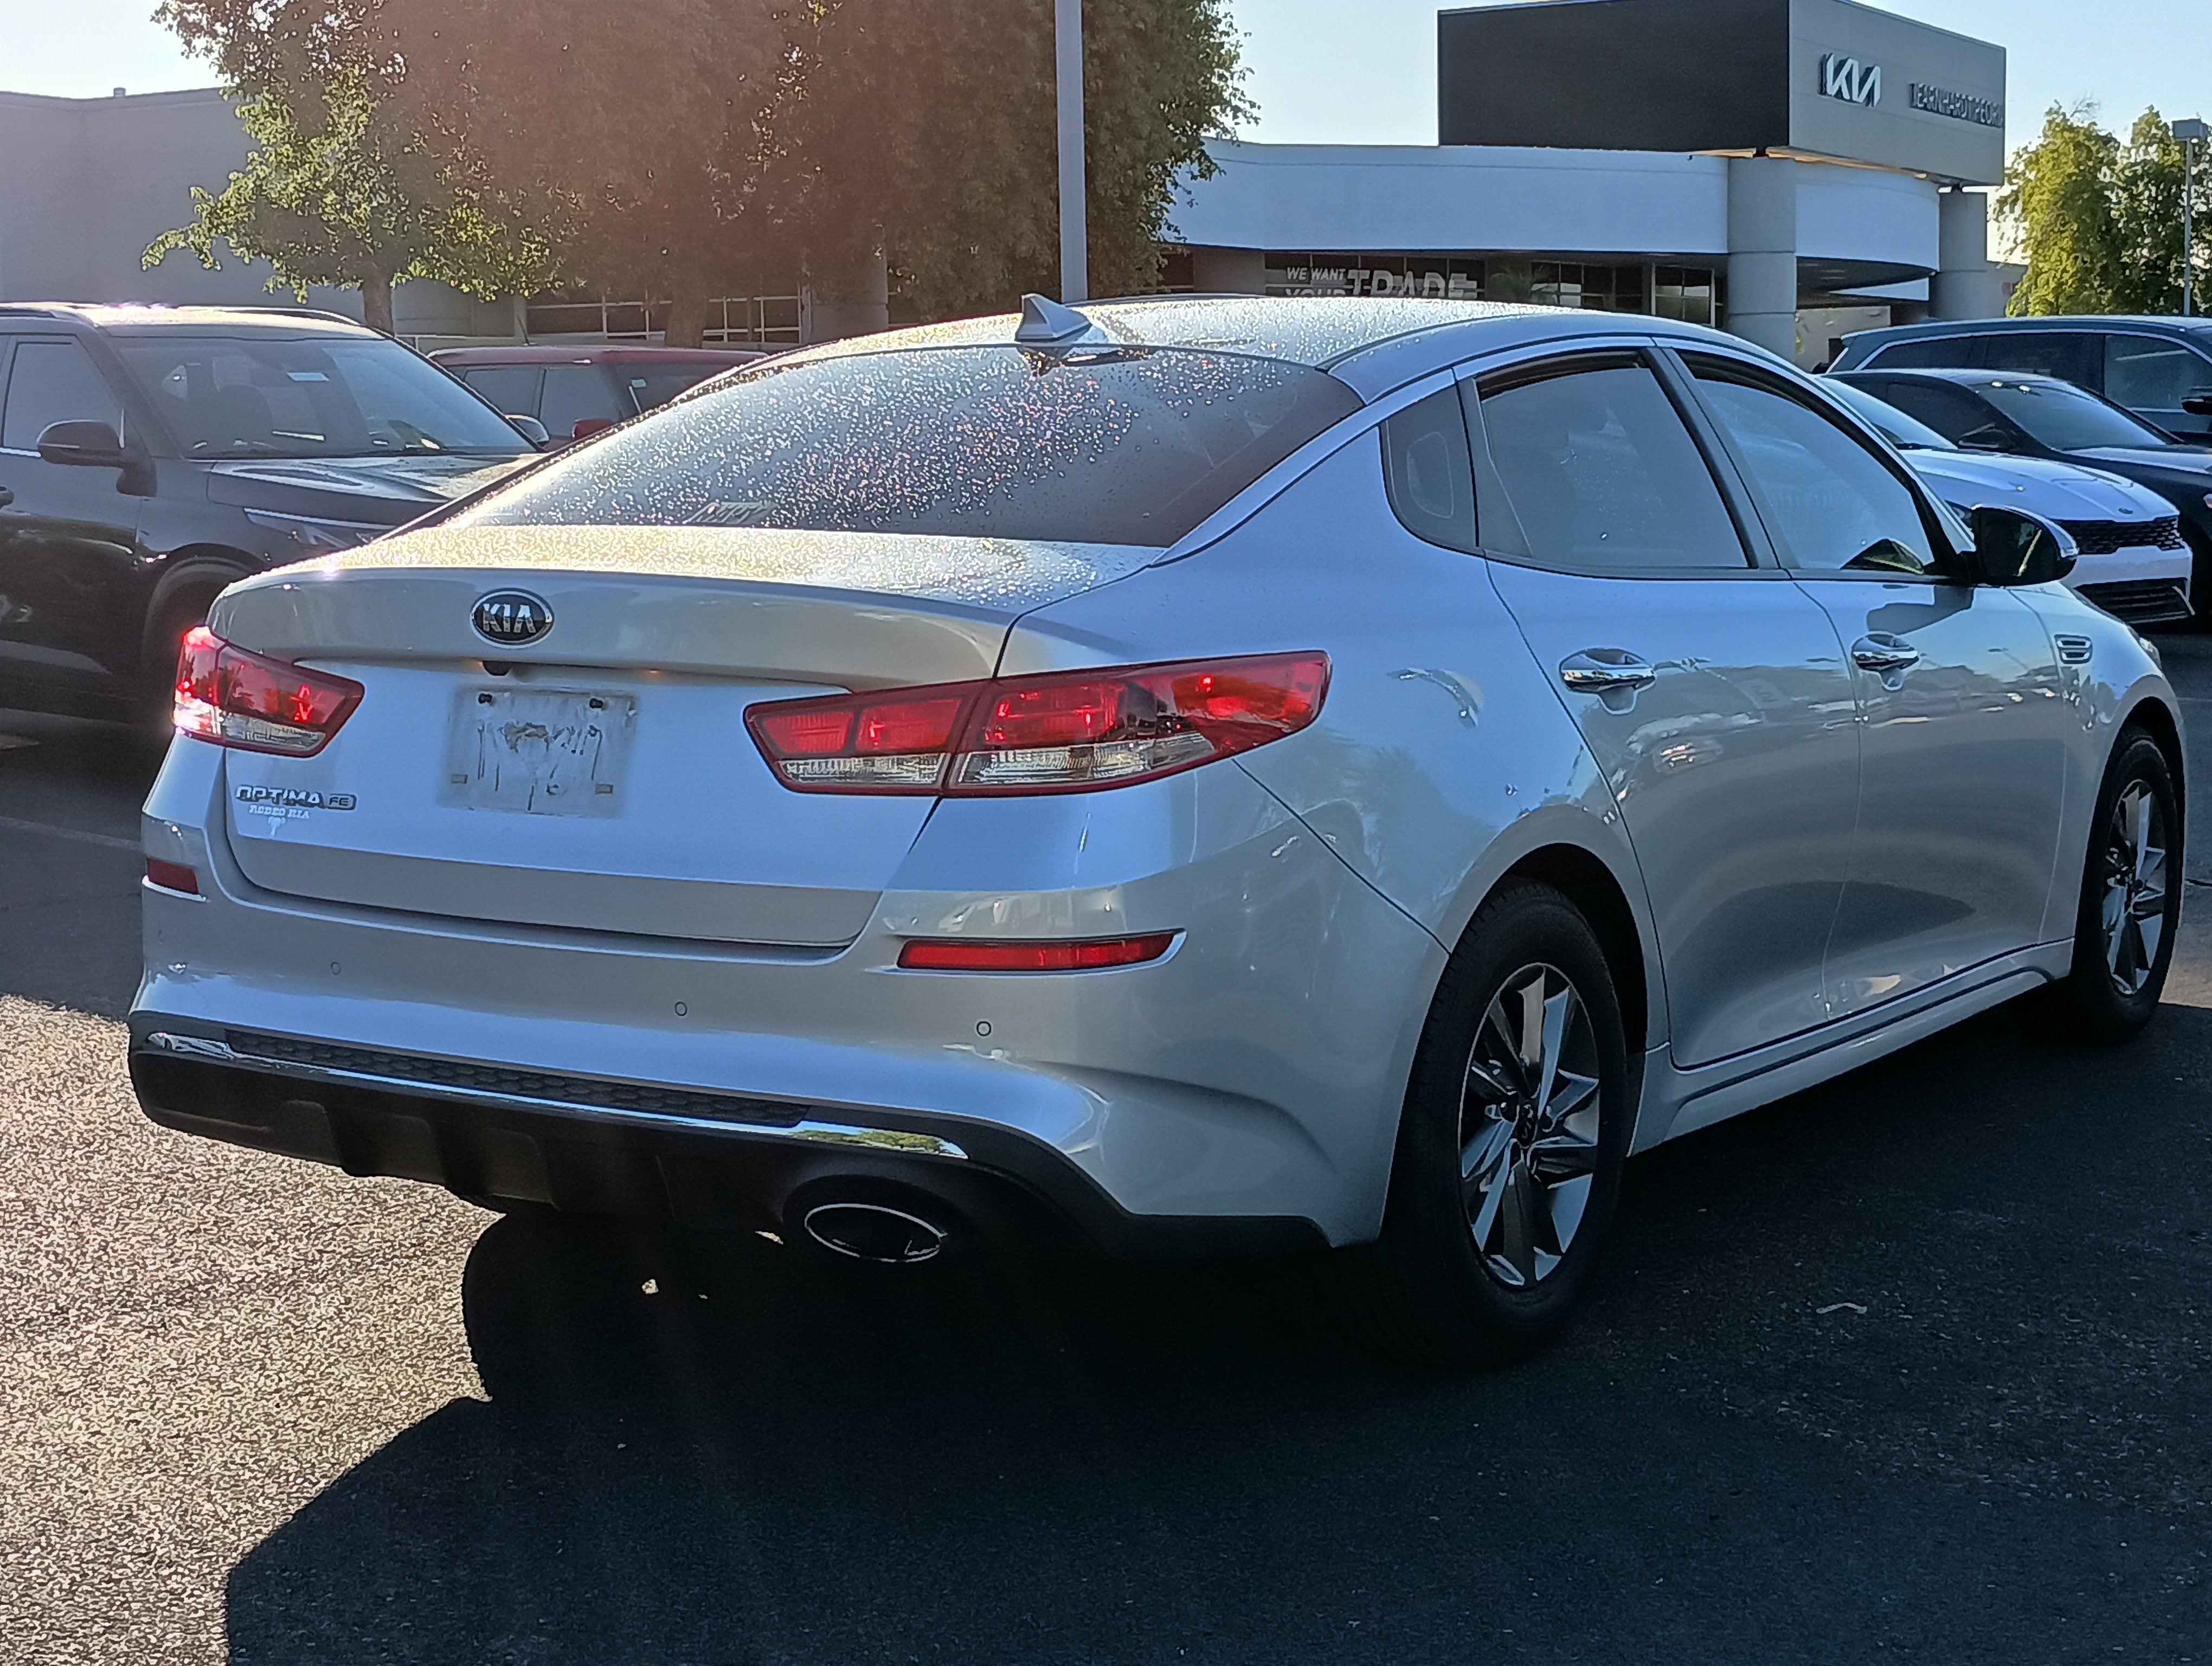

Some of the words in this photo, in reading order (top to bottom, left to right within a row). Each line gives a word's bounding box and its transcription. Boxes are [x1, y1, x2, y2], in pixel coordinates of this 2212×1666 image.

[1287, 267, 1307, 280] WE
[1310, 267, 1346, 280] WANT
[483, 603, 536, 633] KIA
[236, 785, 325, 809] OPTIMA
[329, 796, 349, 806] FE
